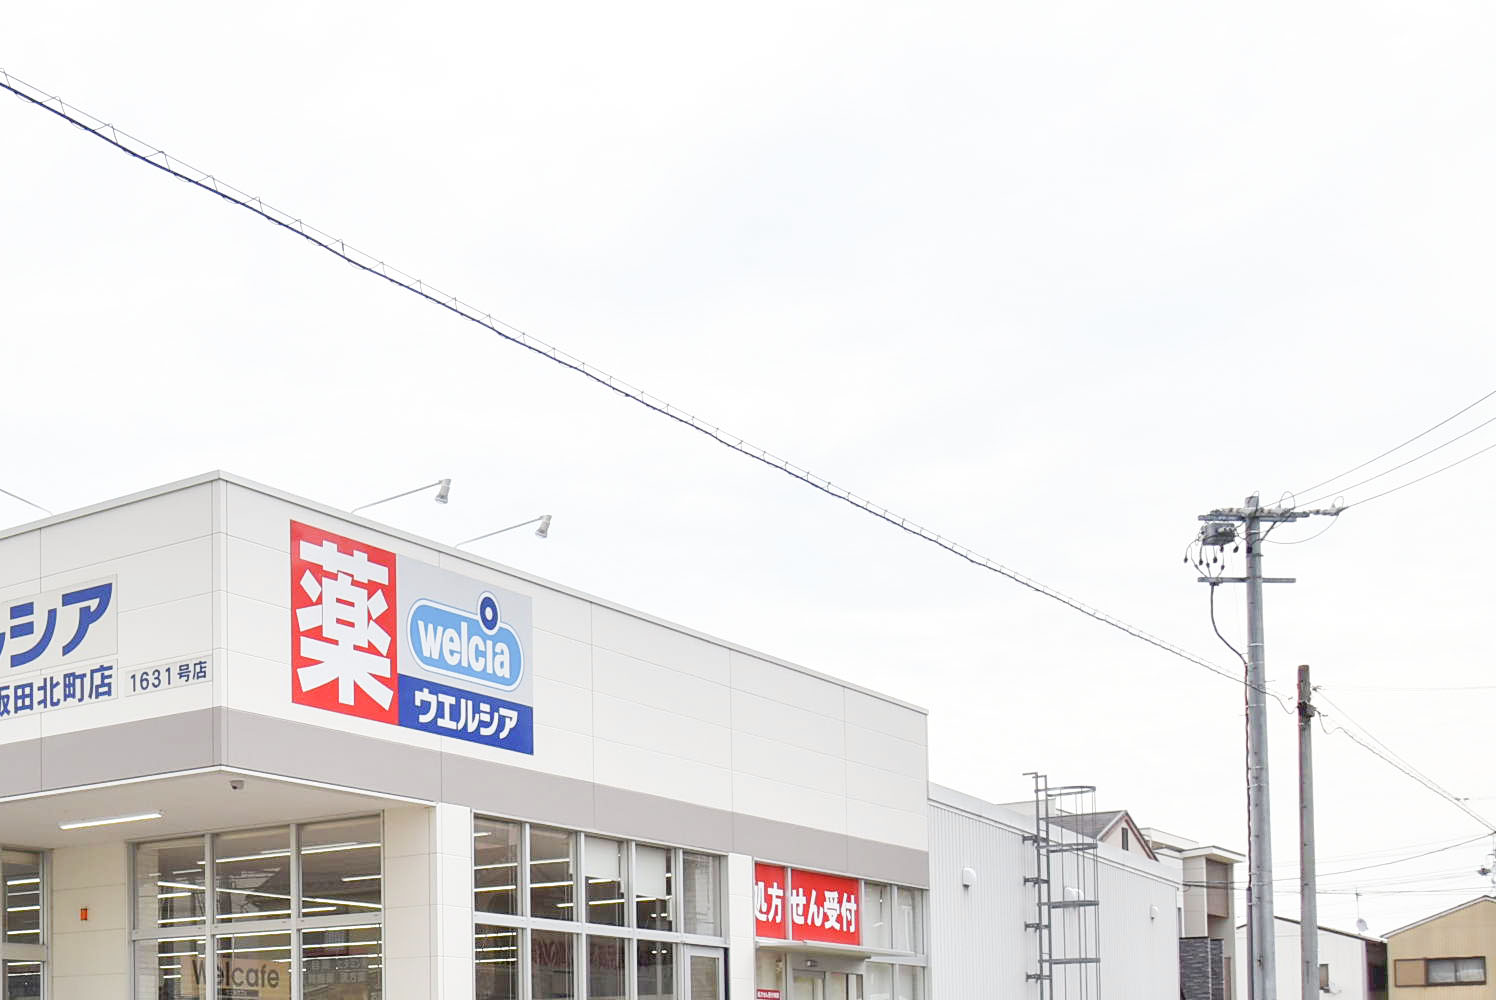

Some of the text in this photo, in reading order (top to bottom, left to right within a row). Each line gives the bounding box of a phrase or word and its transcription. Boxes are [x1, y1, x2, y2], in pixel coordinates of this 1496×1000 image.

[296, 540, 394, 711] 薬
[417, 620, 511, 679] welcia
[130, 661, 208, 693] 1631号店
[414, 688, 518, 739] ウエルシア
[755, 881, 856, 933] 処方せん受付
